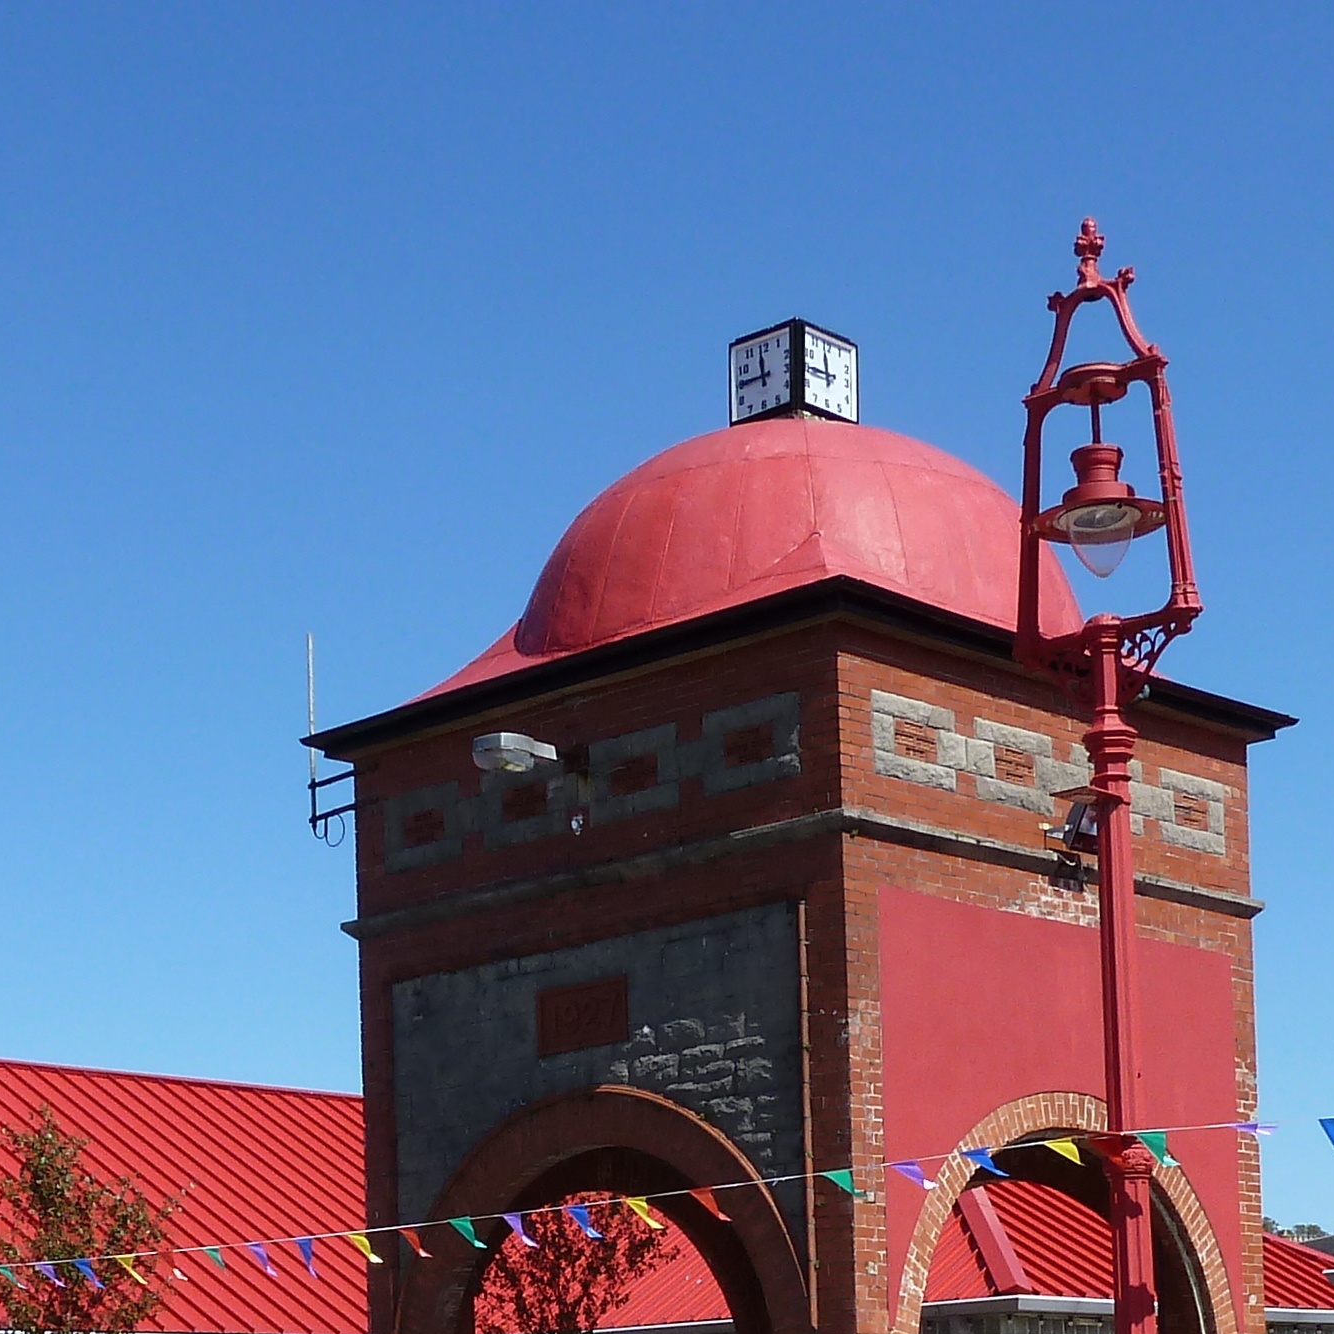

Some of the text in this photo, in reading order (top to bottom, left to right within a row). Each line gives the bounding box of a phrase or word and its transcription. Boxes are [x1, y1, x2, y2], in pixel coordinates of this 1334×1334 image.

[776, 339, 780, 348] 1
[811, 335, 818, 348] 11
[745, 347, 754, 359] 11
[759, 342, 769, 354] 12
[783, 349, 790, 360] 2
[805, 348, 814, 360] 10
[739, 364, 749, 376] 10
[783, 363, 790, 374] 3
[844, 364, 849, 375] 2
[783, 379, 789, 389] 4
[844, 378, 849, 389] 3
[739, 395, 745, 406] 8
[775, 394, 781, 405] 5
[812, 392, 818, 403] 7
[844, 394, 849, 405] 4
[747, 404, 754, 414] 7
[761, 399, 767, 410] 6
[825, 398, 830, 409] 6
[837, 403, 842, 414] 5
[548, 988, 622, 1037] 1927
